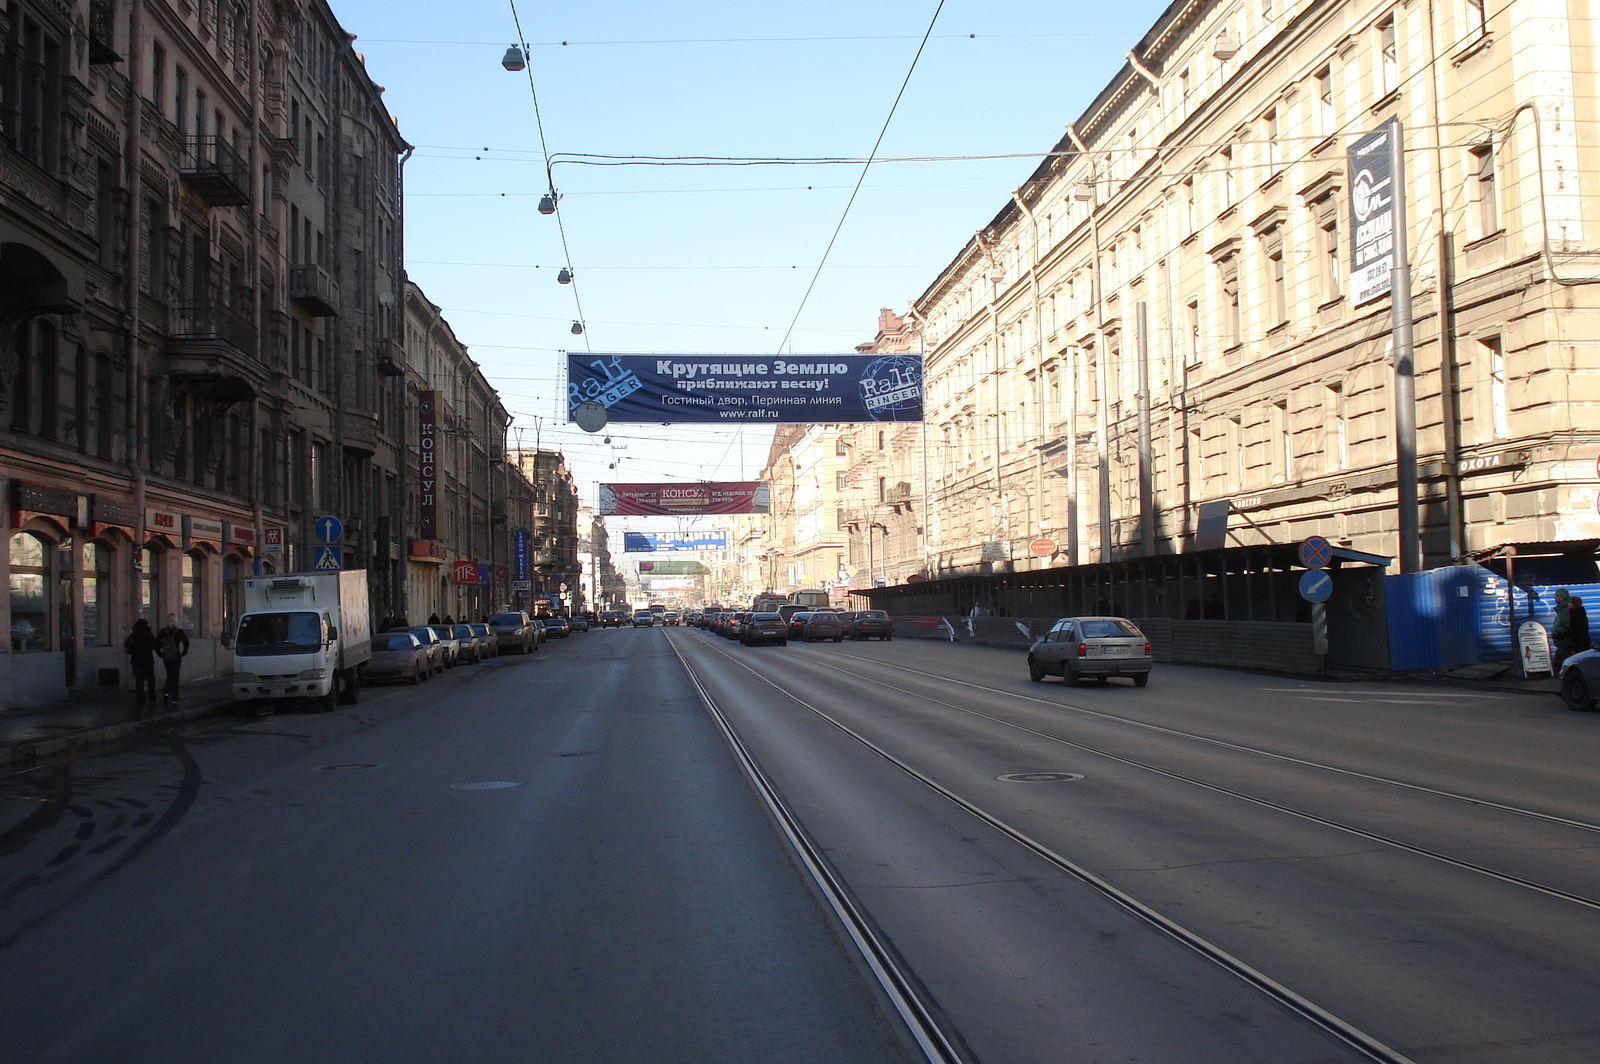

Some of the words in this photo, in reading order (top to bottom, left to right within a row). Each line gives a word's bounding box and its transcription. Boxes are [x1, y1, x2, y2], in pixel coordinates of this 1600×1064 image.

[656, 360, 768, 378] Крутящие
[773, 360, 848, 375] Землю
[677, 378, 777, 391] приближают
[781, 379, 830, 391] весну!
[859, 366, 915, 398] Ralf
[662, 395, 714, 405] Гостиный
[717, 396, 748, 407] двор,
[752, 395, 807, 406] Перинная
[809, 396, 842, 405] линия
[867, 388, 918, 408] RINGER
[720, 408, 779, 418] www.ralf.ru
[421, 423, 434, 506] КОНСУЛ
[1460, 455, 1500, 471] ОХОТА
